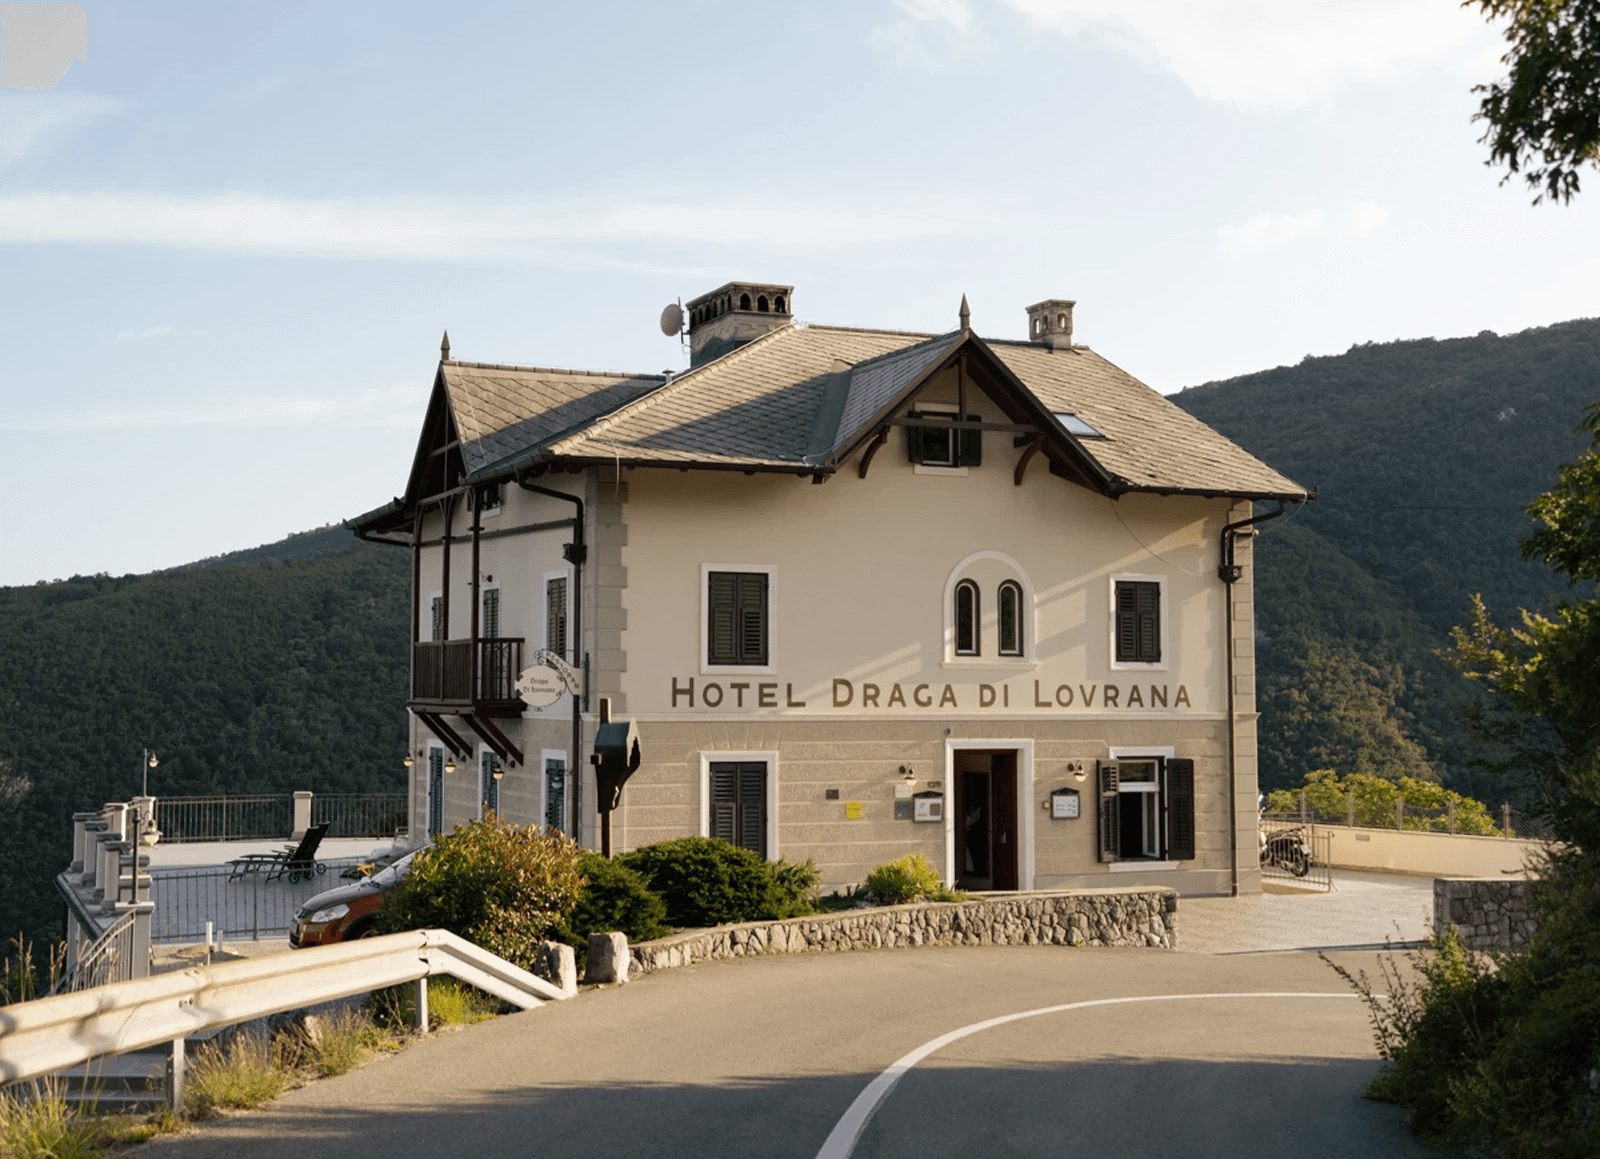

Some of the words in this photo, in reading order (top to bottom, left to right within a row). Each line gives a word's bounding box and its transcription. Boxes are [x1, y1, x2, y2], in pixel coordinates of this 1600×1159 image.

[671, 677, 806, 708] HOTEL
[832, 678, 958, 708] DRAGA
[979, 683, 1009, 708] DI
[1034, 679, 1191, 708] LOVRANA
